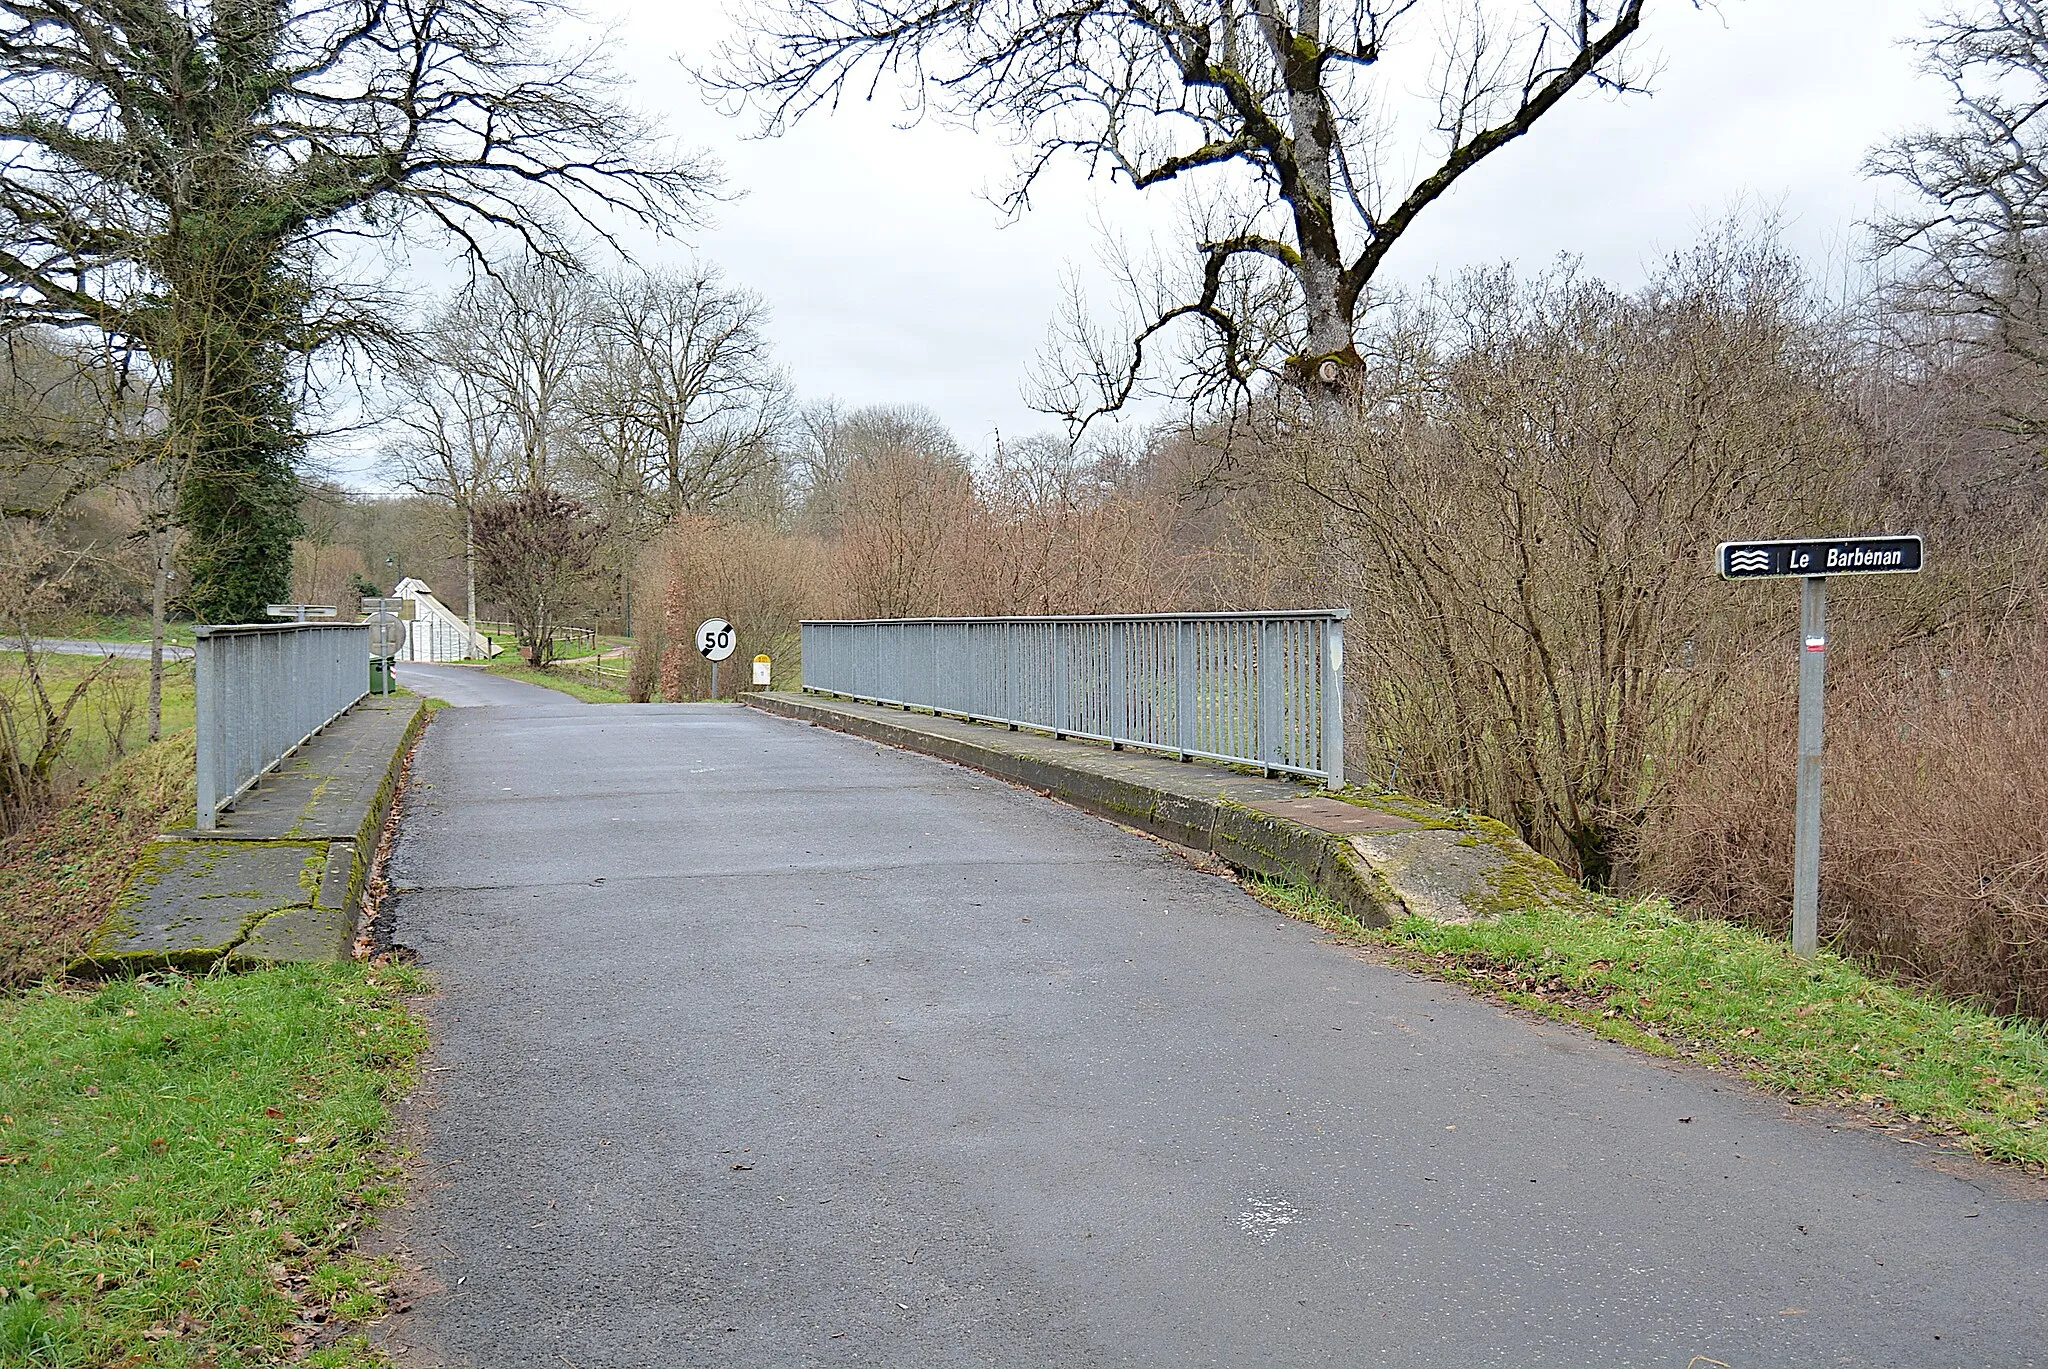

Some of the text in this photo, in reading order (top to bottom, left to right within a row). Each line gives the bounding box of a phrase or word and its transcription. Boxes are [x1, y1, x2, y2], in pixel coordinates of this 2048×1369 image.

[1790, 548, 1901, 568] Le Barbénan
[705, 632, 729, 649] 50
